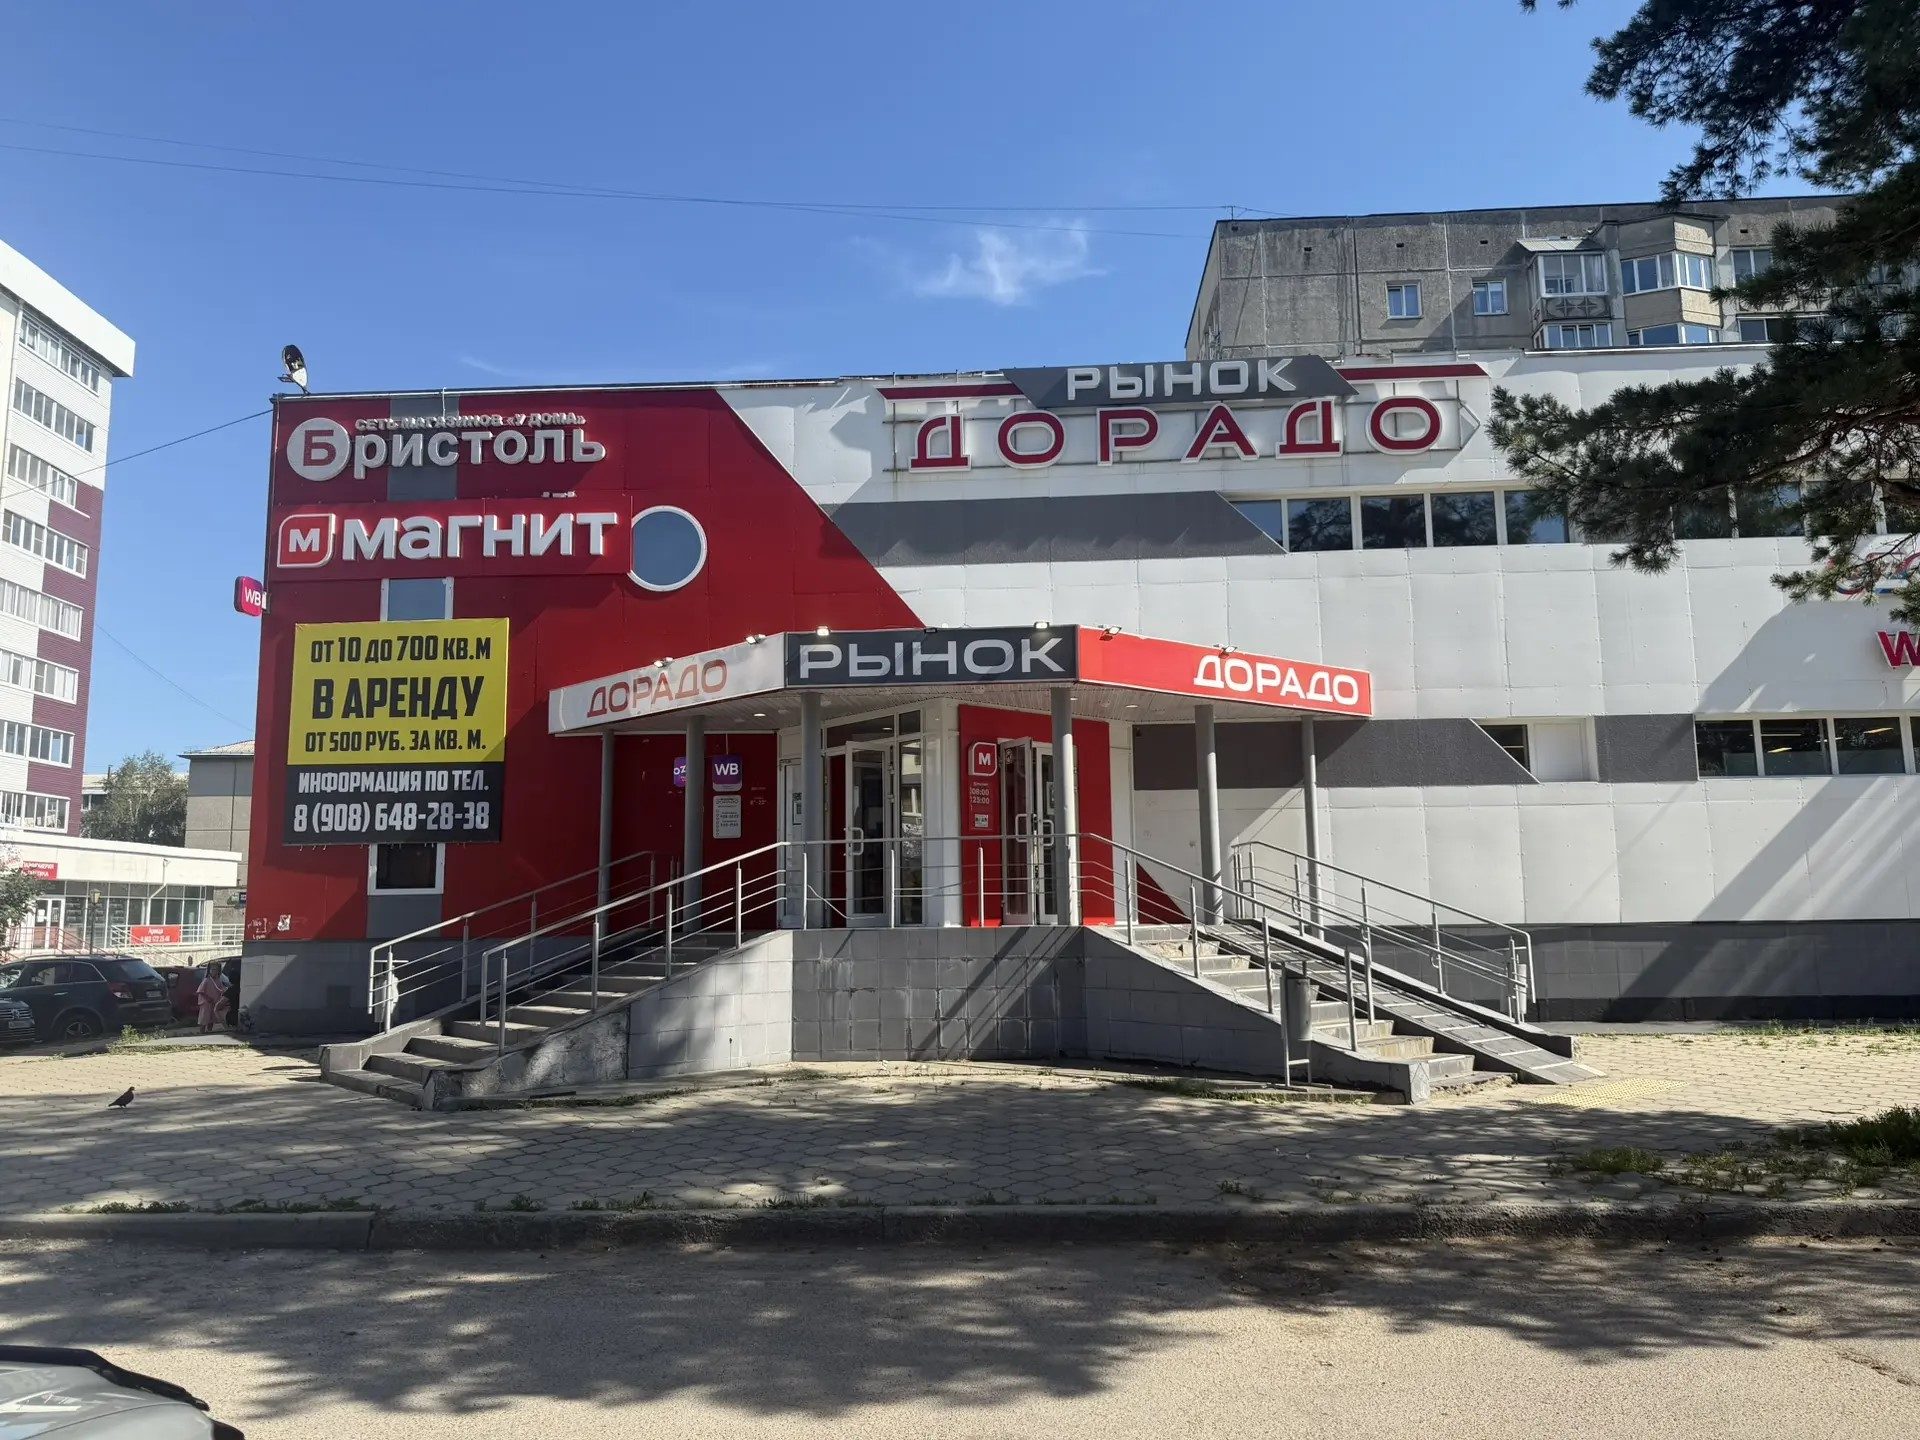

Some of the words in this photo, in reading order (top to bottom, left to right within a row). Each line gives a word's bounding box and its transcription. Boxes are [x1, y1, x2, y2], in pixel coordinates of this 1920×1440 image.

[1066, 358, 1296, 400] РЫНОК
[909, 396, 1442, 473] ДОРАДО
[244, 586, 262, 606] WB
[311, 640, 334, 663] ОТ
[338, 637, 361, 662] 10
[397, 635, 438, 661] 700
[799, 638, 1066, 679] РЫНОК
[312, 678, 334, 719] В
[341, 676, 485, 720] АРЕНДУ
[587, 659, 728, 718] ДОРАДО
[1193, 654, 1359, 706] ДОРАДО
[305, 732, 327, 752] ОТ
[329, 731, 362, 752] 500
[365, 730, 405, 752] РУБ.
[409, 730, 431, 751] ЗА
[434, 729, 462, 750] КВ.
[467, 729, 486, 750] М.
[298, 770, 421, 793] ИНФОРМАЦИЯ
[424, 770, 448, 792] ПО
[452, 769, 489, 791] ТЕЛ.
[714, 763, 739, 775] WB
[293, 804, 308, 833] 8
[312, 802, 370, 833] (908)
[374, 801, 490, 832] 648-28-38
